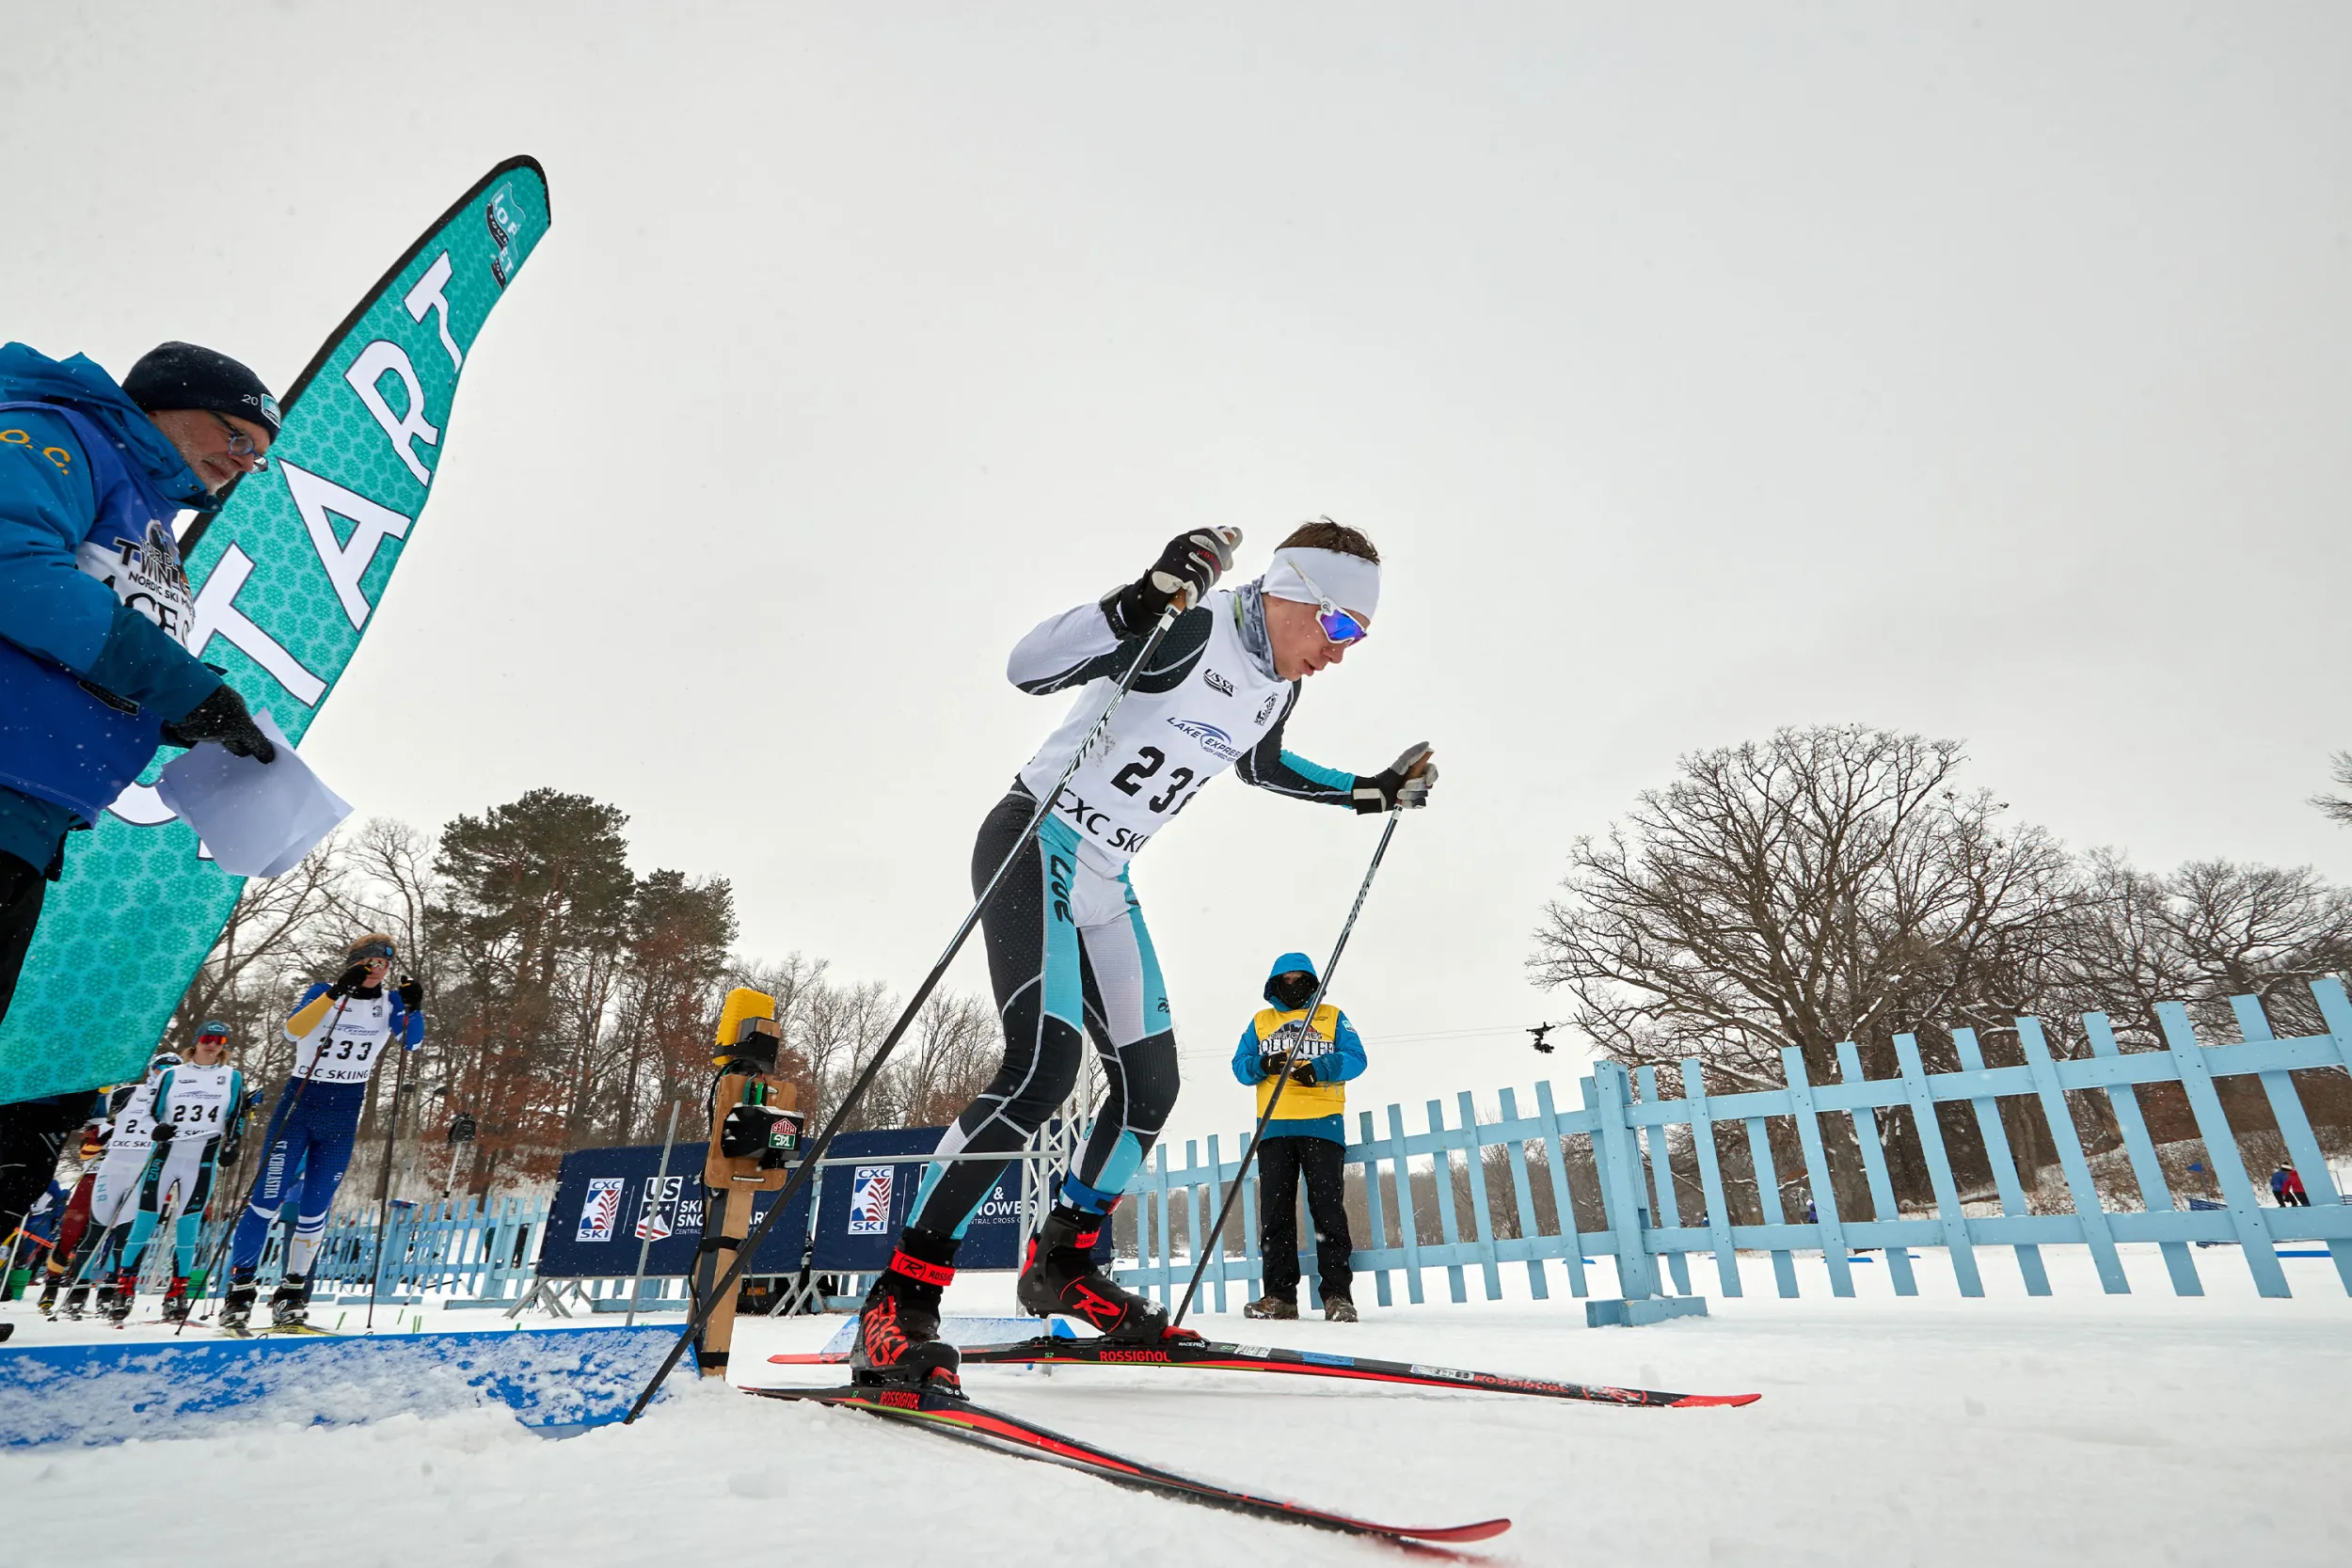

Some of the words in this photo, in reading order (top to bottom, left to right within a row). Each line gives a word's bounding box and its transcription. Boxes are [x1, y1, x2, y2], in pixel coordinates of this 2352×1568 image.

[241, 394, 259, 405] 20
[106, 250, 463, 861] TART
[128, 571, 163, 596] NORDIC
[164, 589, 180, 603] SKI
[1203, 668, 1235, 693] USSA
[1167, 717, 1201, 738] LAKE
[318, 1036, 373, 1061] 233
[326, 1069, 369, 1080] SKIING
[172, 1104, 219, 1123] 234
[772, 1119, 795, 1134] HEUER
[773, 1133, 790, 1148] TAG
[859, 1168, 892, 1179] CXC
[592, 1180, 621, 1190] CXC
[645, 1178, 681, 1200] US
[993, 1186, 1005, 1200] &
[679, 1199, 703, 1213] SKI
[851, 1221, 885, 1231] SKI
[993, 1215, 1016, 1225] CROSS
[580, 1229, 610, 1239] SKI
[675, 1227, 702, 1236] CENTRAL
[1100, 1350, 1172, 1363] ROSSIGNOL
[880, 1390, 921, 1411] ROSSIGNOL
